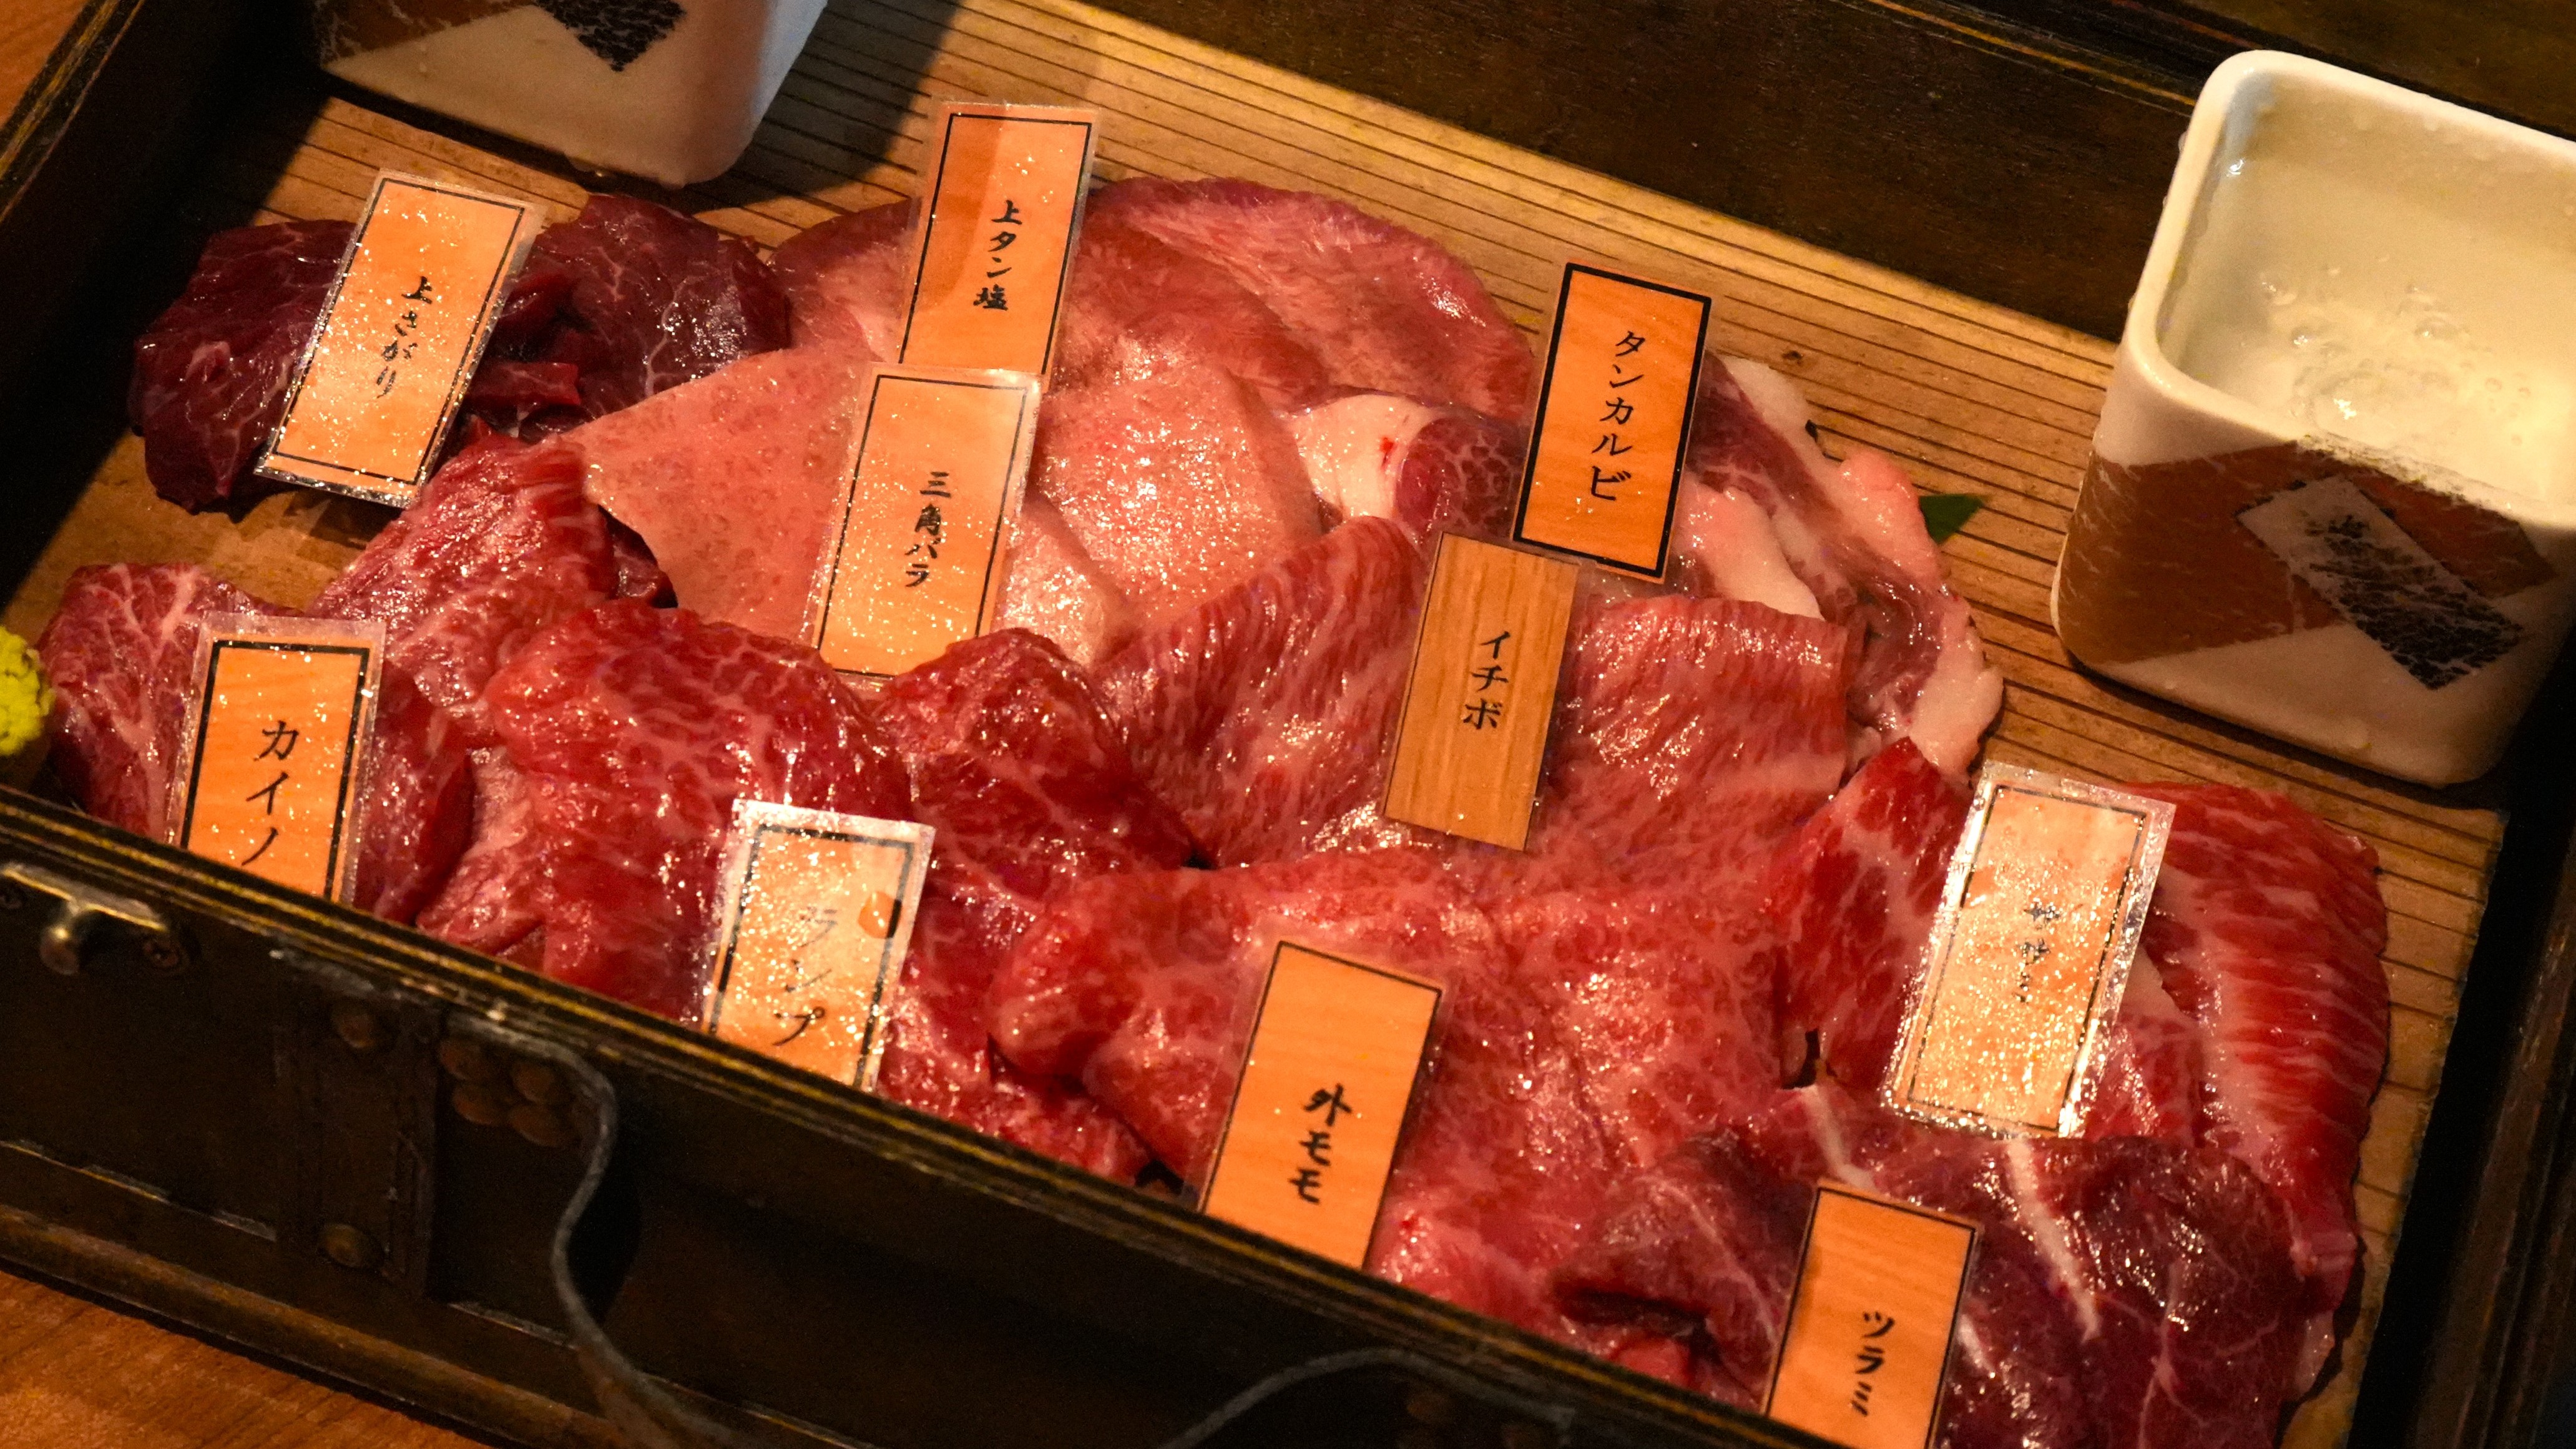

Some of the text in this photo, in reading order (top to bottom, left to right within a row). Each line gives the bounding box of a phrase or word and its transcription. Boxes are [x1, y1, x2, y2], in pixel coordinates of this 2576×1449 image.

[972, 199, 1022, 311] 上タン塩
[376, 275, 433, 398] 上さがり
[1591, 330, 1645, 501] タンカルビ
[904, 471, 951, 587] 三角バラ
[1462, 631, 1511, 730] イチボ
[772, 906, 838, 1046] ランプ
[1287, 1083, 1353, 1206] 外モモ
[1850, 1311, 1896, 1417] ツラミ
